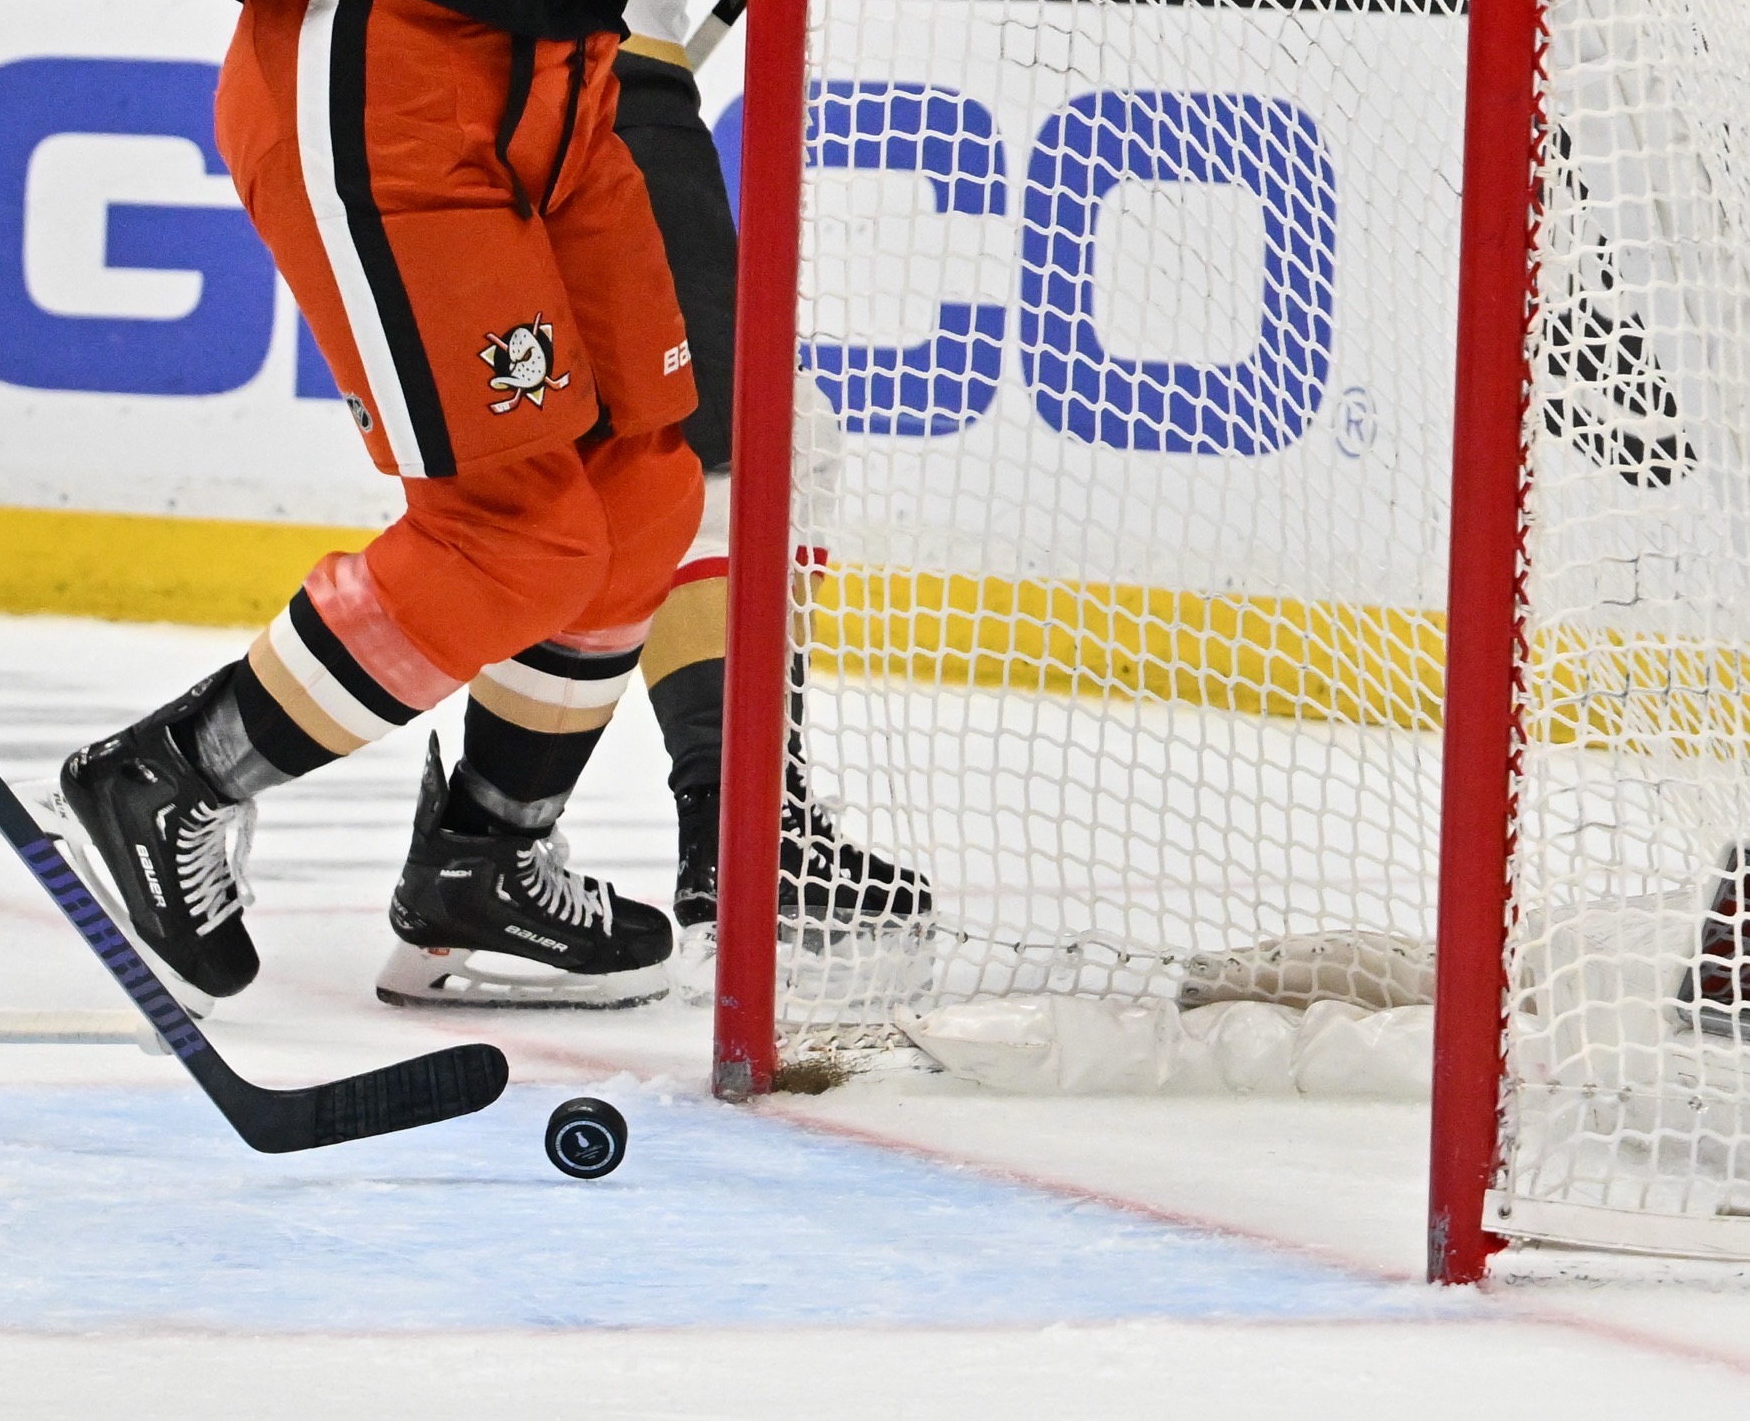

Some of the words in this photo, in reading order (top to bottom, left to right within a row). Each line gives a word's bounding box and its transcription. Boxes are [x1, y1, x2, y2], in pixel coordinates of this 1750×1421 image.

[663, 338, 692, 377] BA
[135, 843, 168, 908] BAUER
[18, 837, 208, 1059] WARRIOR
[503, 924, 569, 954] BAUER
